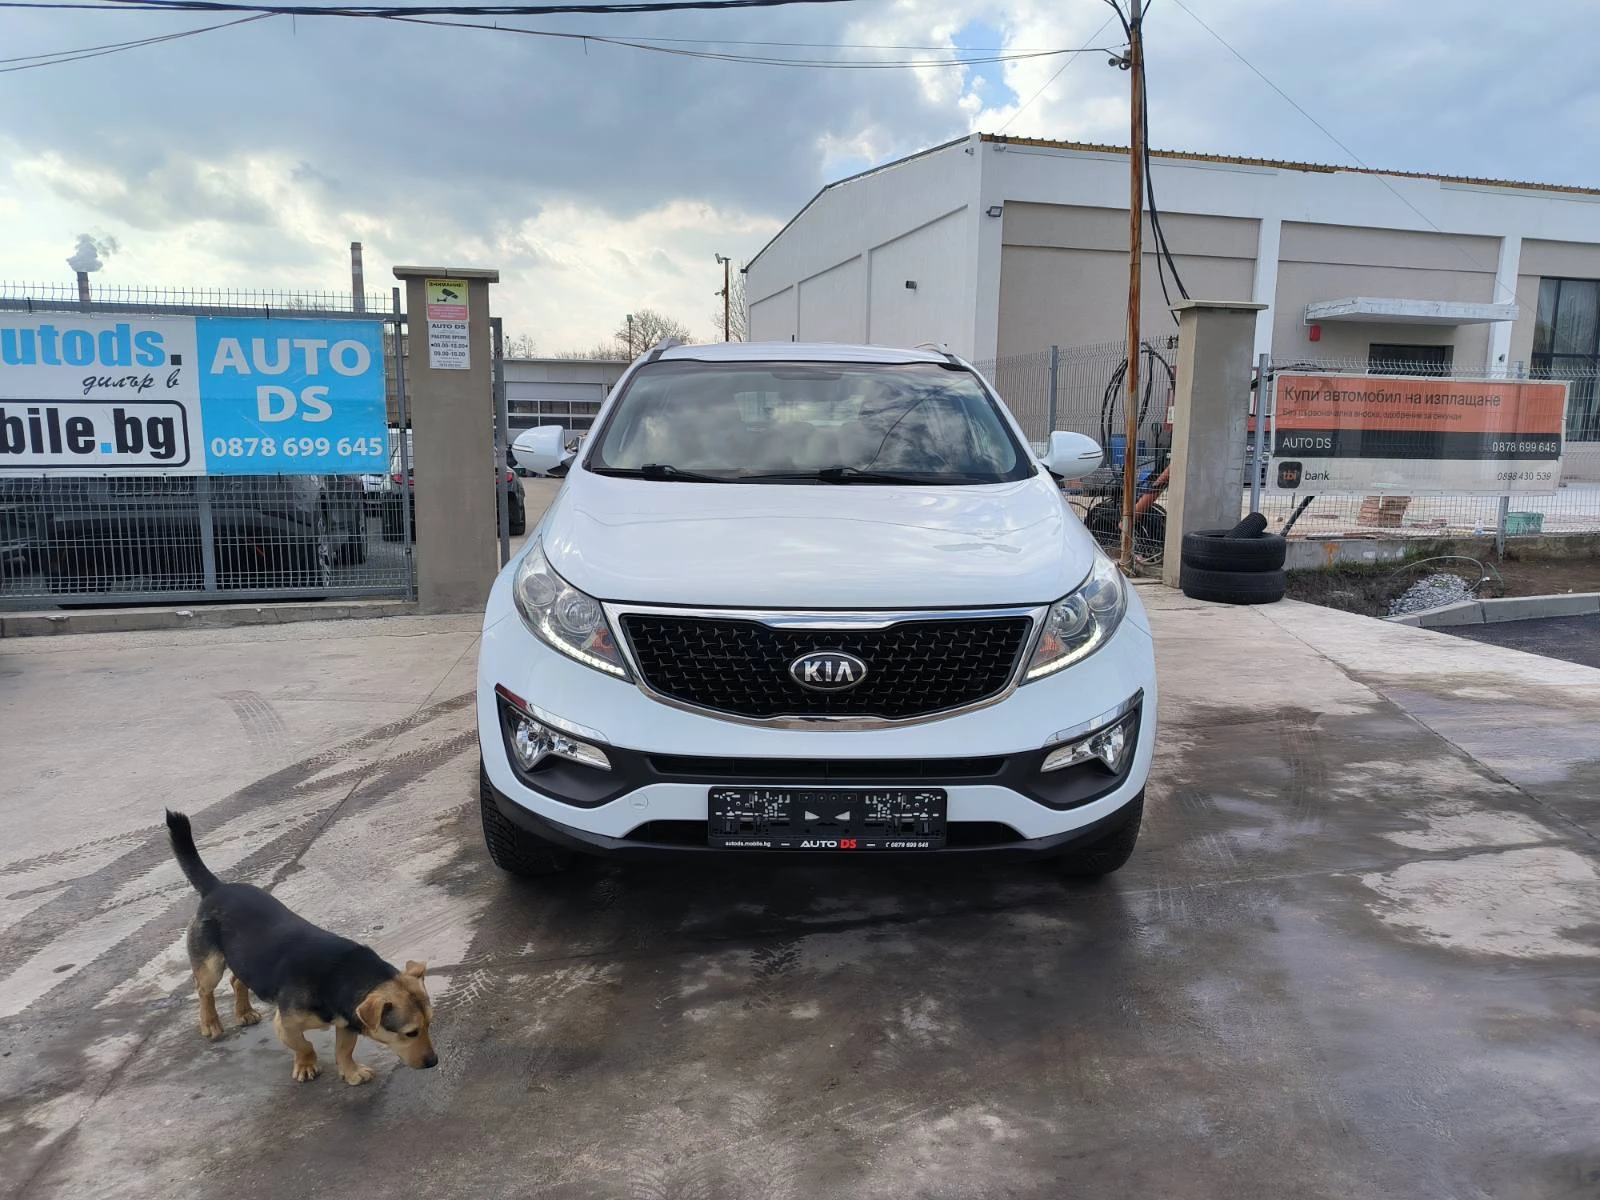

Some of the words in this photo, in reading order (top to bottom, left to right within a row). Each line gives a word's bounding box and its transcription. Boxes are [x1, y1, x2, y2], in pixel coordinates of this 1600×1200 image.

[210, 337, 371, 377] AUTO
[82, 373, 155, 395] дилър
[166, 368, 181, 389] в
[256, 385, 333, 423] DS
[1284, 386, 1319, 404] Купи
[1323, 389, 1401, 404] автомобил
[1405, 393, 1421, 404] на
[1425, 393, 1501, 408] изплащане
[0, 407, 176, 460] bile.bg
[1282, 437, 1313, 449] AUTO
[1316, 438, 1332, 449] DS
[211, 437, 277, 457] 0878
[282, 437, 330, 457] 699
[336, 437, 383, 456] 645
[1492, 441, 1516, 453] 0878
[1519, 442, 1536, 453] 699
[1538, 442, 1557, 453] 645
[1283, 469, 1297, 480] tbi
[1304, 470, 1330, 481] bank
[1497, 472, 1517, 481] 0898
[1518, 472, 1534, 481] 430
[1536, 472, 1551, 481] 539
[803, 660, 854, 682] KIA
[800, 840, 837, 848] AUTO
[840, 839, 857, 849] DS
